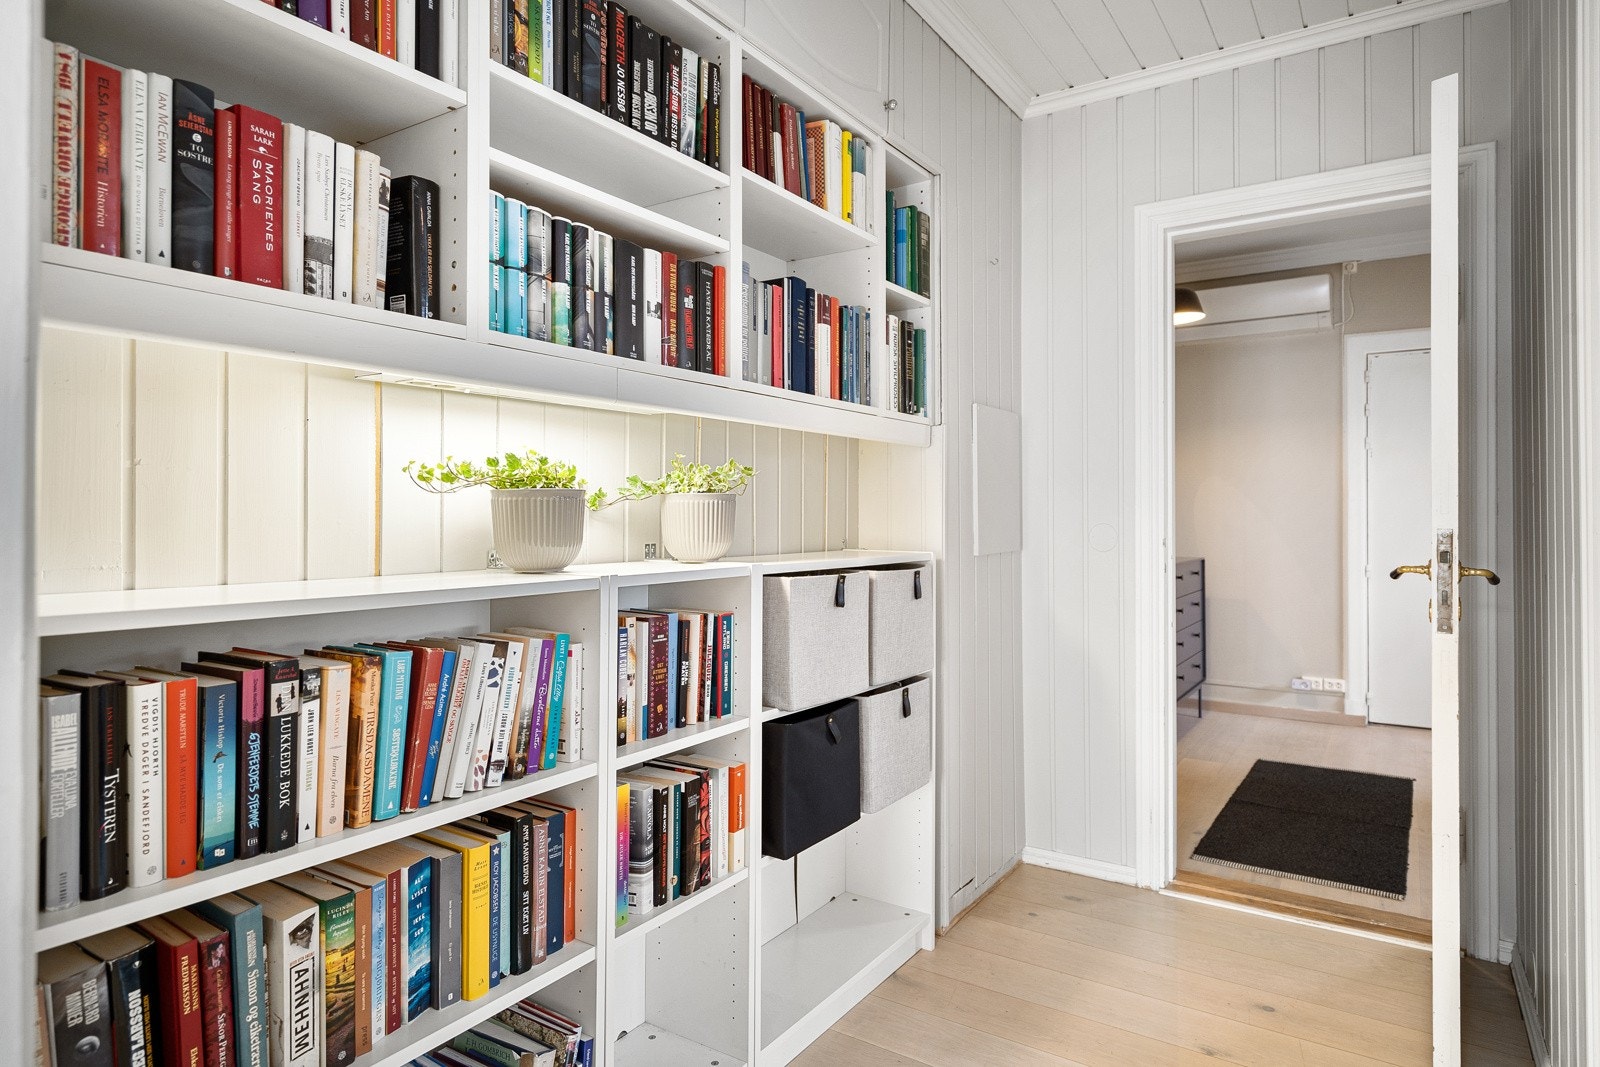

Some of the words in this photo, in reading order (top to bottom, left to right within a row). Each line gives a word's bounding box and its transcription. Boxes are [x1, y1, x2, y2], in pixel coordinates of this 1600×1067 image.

[616, 12, 625, 64] MACBETH
[616, 64, 625, 77] JO
[688, 72, 697, 89] DAN
[98, 76, 109, 106] ELSA
[135, 80, 144, 113] ELENA
[158, 92, 168, 110] IAN
[616, 78, 626, 112] NESBØ
[687, 92, 696, 120] BROWN
[644, 91, 658, 123] NESBØ
[250, 124, 276, 139] SARAH
[632, 119, 641, 130] JO
[644, 121, 658, 135] JO
[134, 118, 143, 172] FERRANTE
[190, 143, 204, 153] TO
[253, 135, 274, 147] LARK
[252, 158, 262, 205] SANG
[96, 181, 109, 227] Historien
[158, 187, 166, 227] Barneloven
[265, 162, 274, 252] MAORIENES
[669, 263, 676, 273] DA
[397, 660, 406, 673] LARS
[441, 673, 450, 692] André
[179, 688, 187, 711] TRUDE
[217, 693, 226, 724] Victoria
[437, 693, 446, 717] Aciman
[141, 699, 149, 737] TREDVE
[50, 726, 79, 773] ALLENDE
[216, 725, 225, 749] Hislop
[280, 716, 290, 777] LUKKEDE
[216, 763, 224, 773] De
[248, 732, 260, 793] GJENFERDETS
[361, 709, 376, 818] TIRSDAGSDAMENE
[50, 772, 65, 819] FORTELLER
[216, 792, 222, 800] er
[279, 782, 290, 809] BOK
[330, 777, 338, 791] fra
[103, 768, 120, 844] TYSTEREN
[216, 801, 224, 823] elsket
[248, 794, 260, 830] STEMME
[411, 886, 428, 900] LYSET
[492, 916, 498, 926] DE
[181, 955, 191, 1015] FREDRIKSSON
[190, 964, 199, 1012] MARIANNE
[247, 968, 260, 1004] Simon
[65, 991, 84, 1028] MINIER
[82, 978, 100, 1025] BERNARD
[246, 1005, 259, 1021] og
[127, 989, 145, 1050] LARSSON
